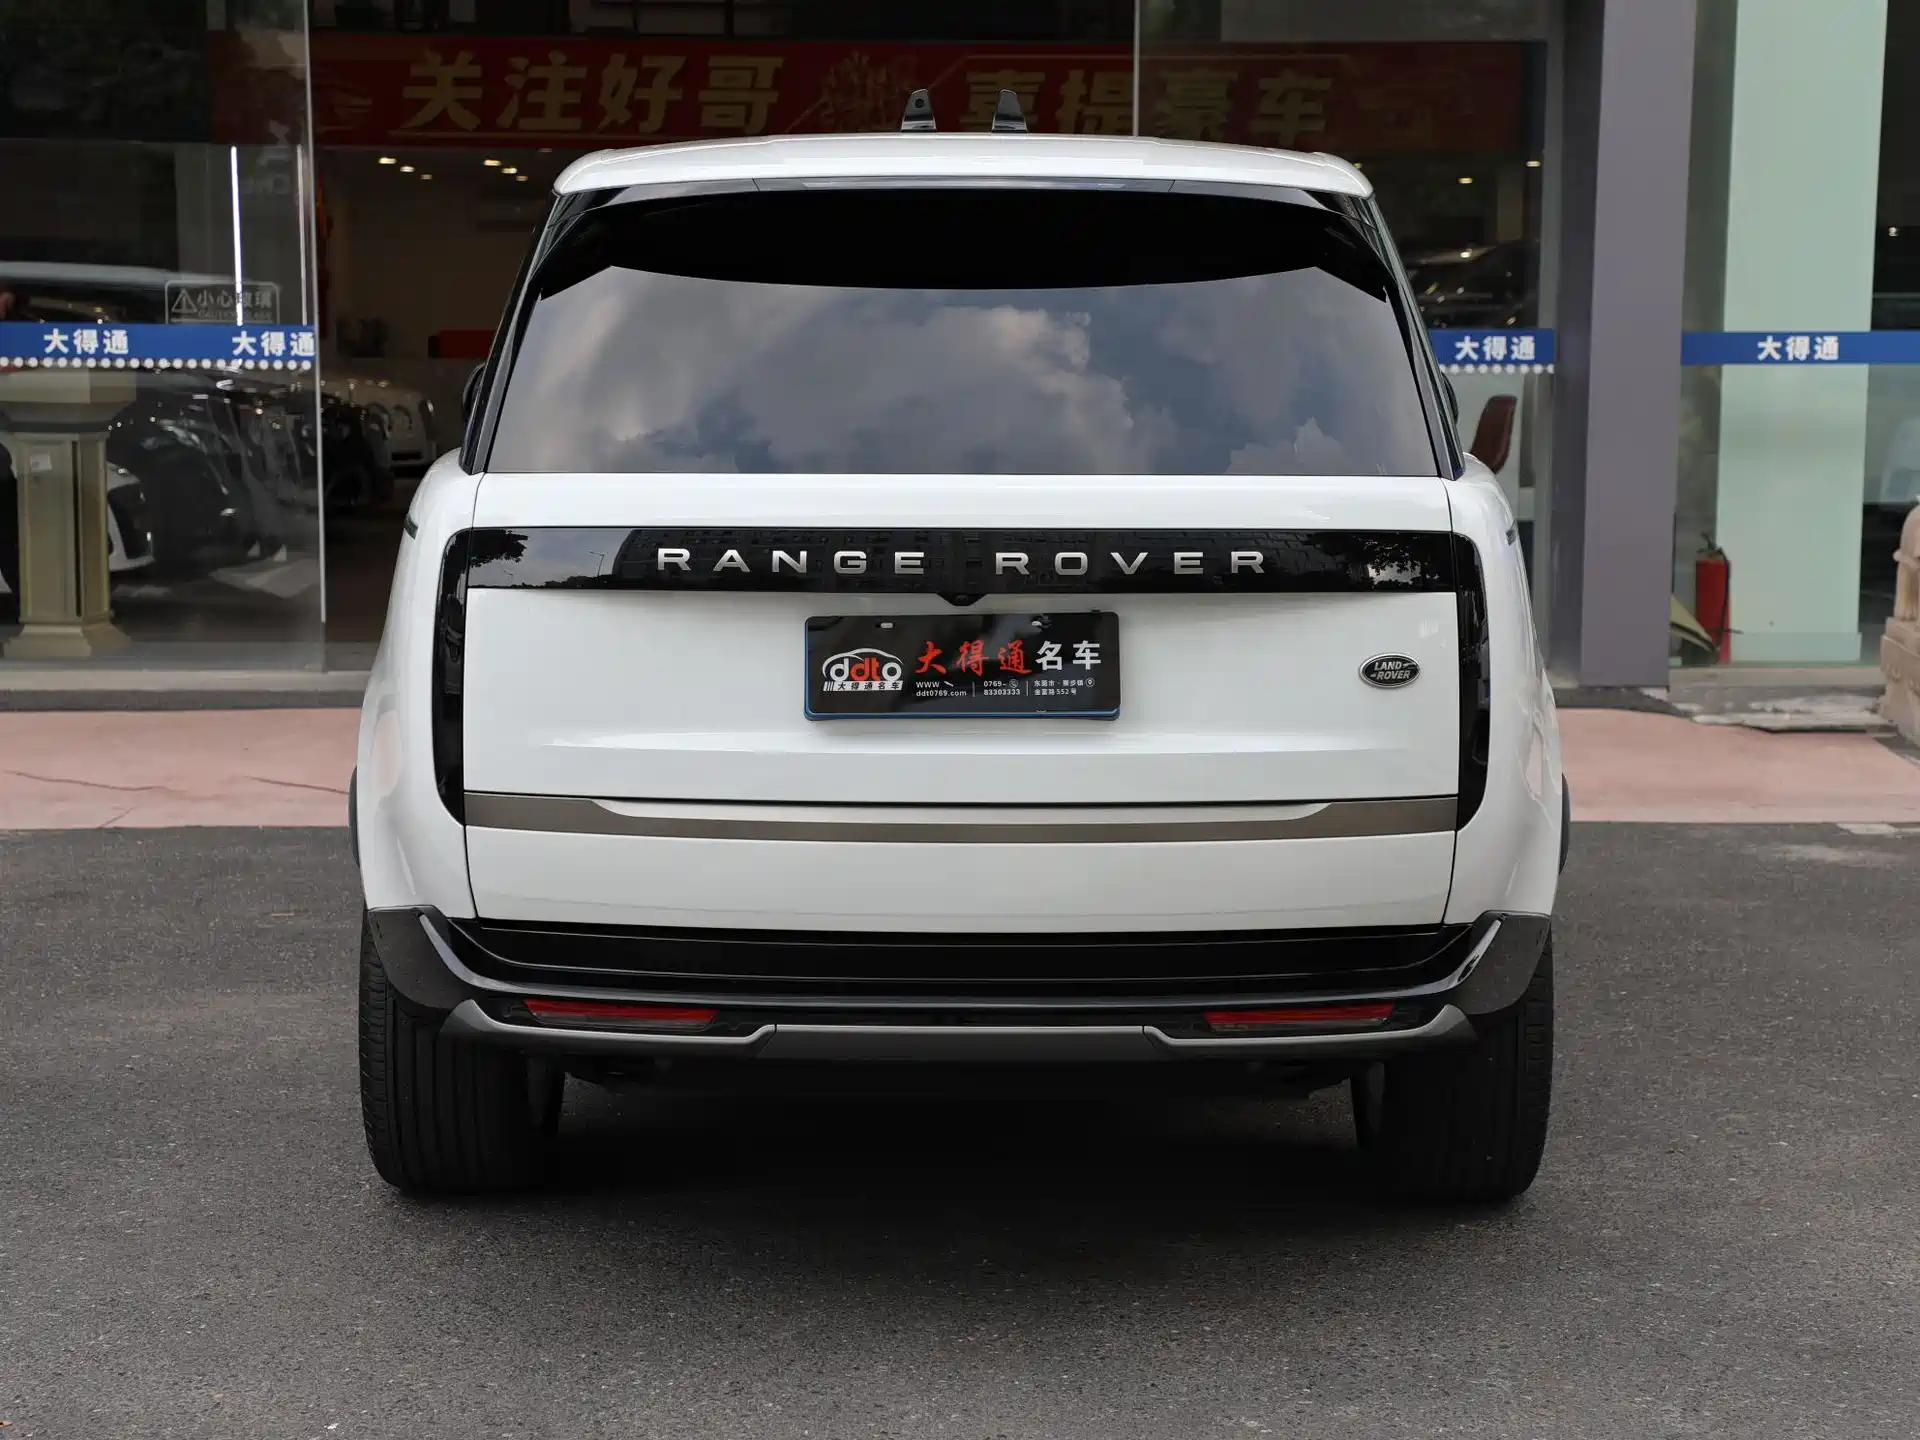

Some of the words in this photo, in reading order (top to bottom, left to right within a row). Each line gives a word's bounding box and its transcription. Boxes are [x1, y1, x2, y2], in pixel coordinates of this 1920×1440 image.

[402, 50, 785, 134] 关注好哥
[43, 328, 130, 354] 大得通
[232, 331, 316, 357] 大得通
[1454, 335, 1537, 361] 大得通
[1757, 335, 1840, 361] 大得通
[656, 548, 924, 575] RANGE
[995, 551, 1265, 576] ROVER
[829, 657, 902, 682] ddto
[915, 639, 1102, 677] 大得通名车
[1374, 661, 1402, 670] LAND
[837, 682, 900, 690] 大得通名车
[1376, 670, 1411, 680] ROVER
